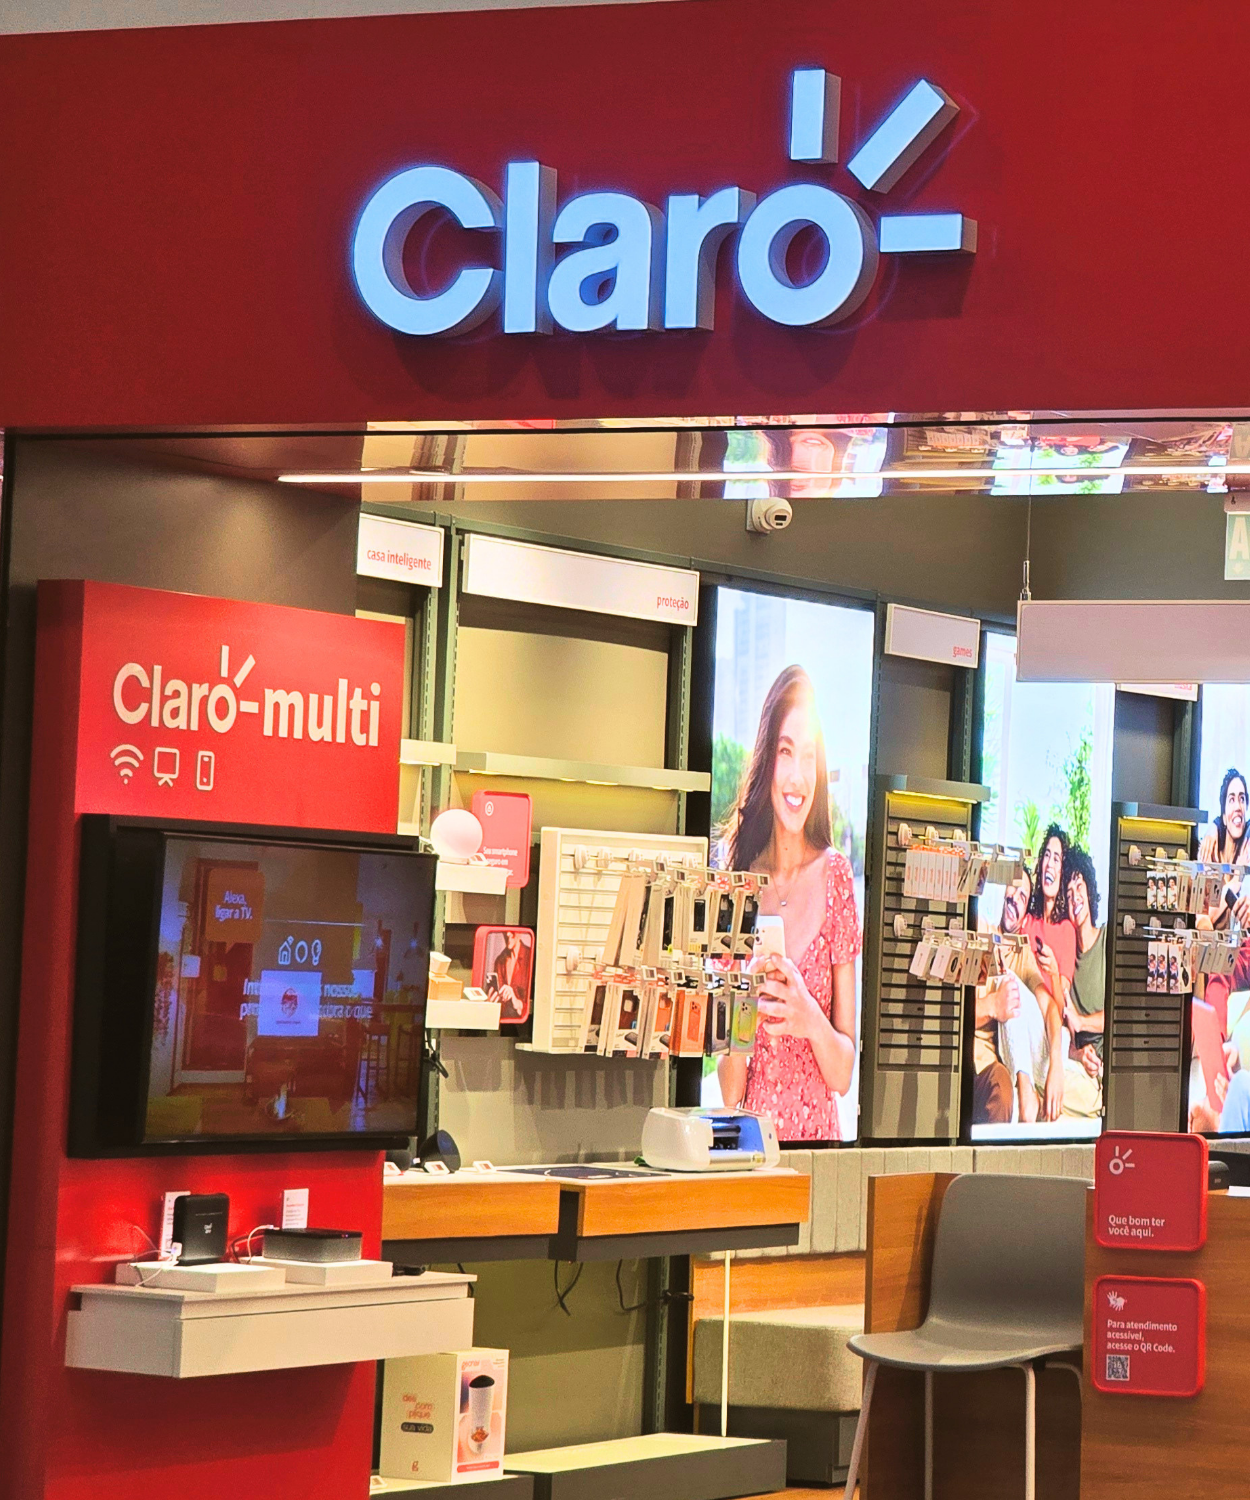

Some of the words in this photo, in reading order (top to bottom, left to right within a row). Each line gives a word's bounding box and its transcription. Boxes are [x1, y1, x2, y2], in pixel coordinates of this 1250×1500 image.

[353, 160, 880, 337] Claro
[367, 549, 386, 562] casa
[387, 550, 432, 571] inteligente
[656, 596, 689, 611] proteção
[953, 646, 973, 658] games
[1108, 1214, 1128, 1227] Que
[1129, 1215, 1150, 1226] bom
[1151, 1217, 1165, 1227] ter
[1108, 1225, 1130, 1236] você
[1131, 1227, 1155, 1239] aqui.
[1107, 1319, 1125, 1329] Para
[1126, 1321, 1178, 1332] atendimento
[1106, 1341, 1133, 1351] acesse
[1133, 1343, 1139, 1351] o
[1140, 1342, 1152, 1353] QR
[1153, 1343, 1176, 1353] Code.
